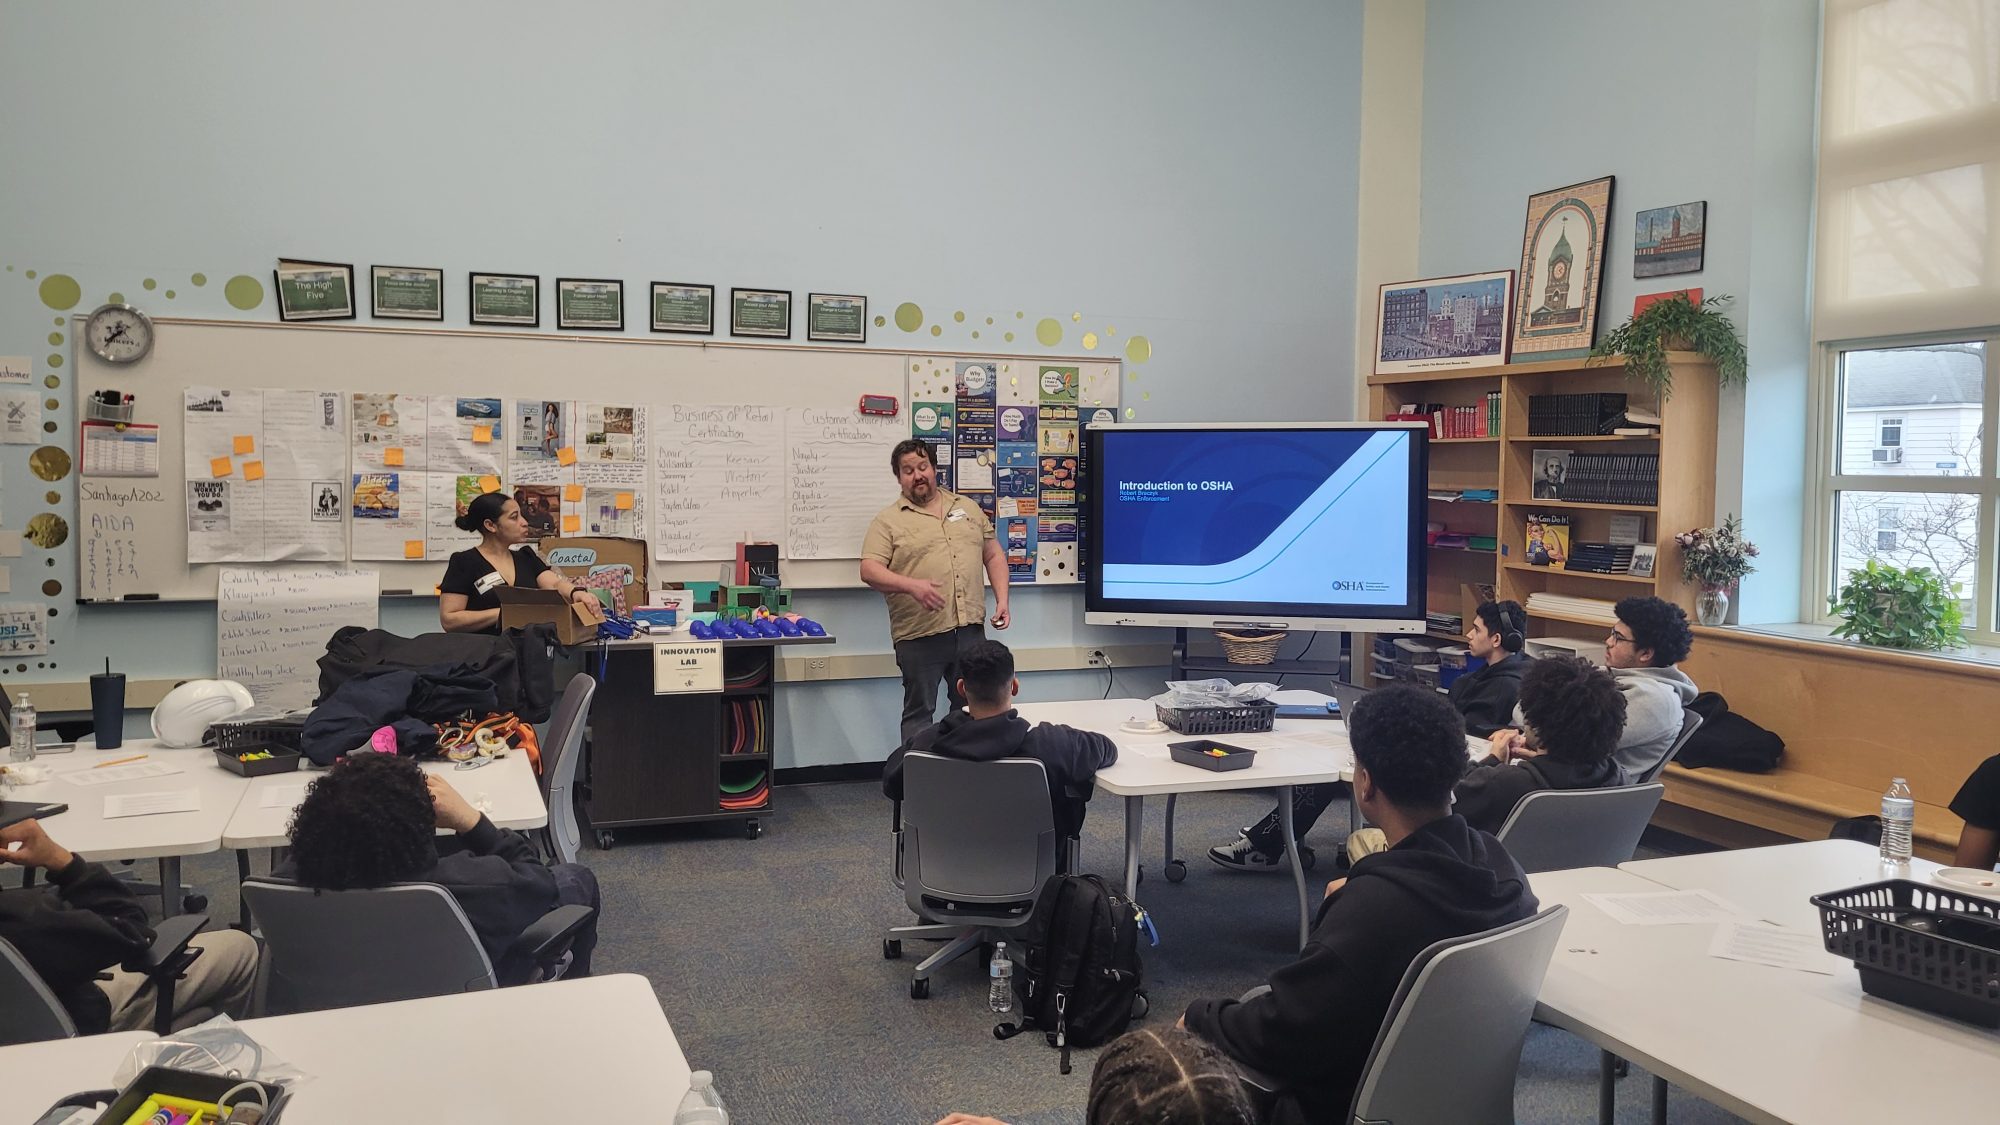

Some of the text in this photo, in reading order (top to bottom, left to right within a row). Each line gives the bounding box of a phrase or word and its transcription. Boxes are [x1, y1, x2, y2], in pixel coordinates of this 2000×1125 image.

[313, 281, 333, 290] High
[306, 291, 324, 300] Five
[673, 404, 774, 423] Business of Retail
[802, 408, 849, 425] Customer
[688, 424, 744, 438] Certification
[823, 427, 872, 440] Certification
[1119, 481, 1234, 491] Introduction to OSHA
[91, 513, 134, 531] AIDA
[1528, 514, 1569, 524] We Can Do It!
[550, 551, 595, 564] Coastal
[1332, 581, 1364, 591] OSHA
[660, 647, 717, 656] INNOVATION
[680, 658, 698, 666] LAB
